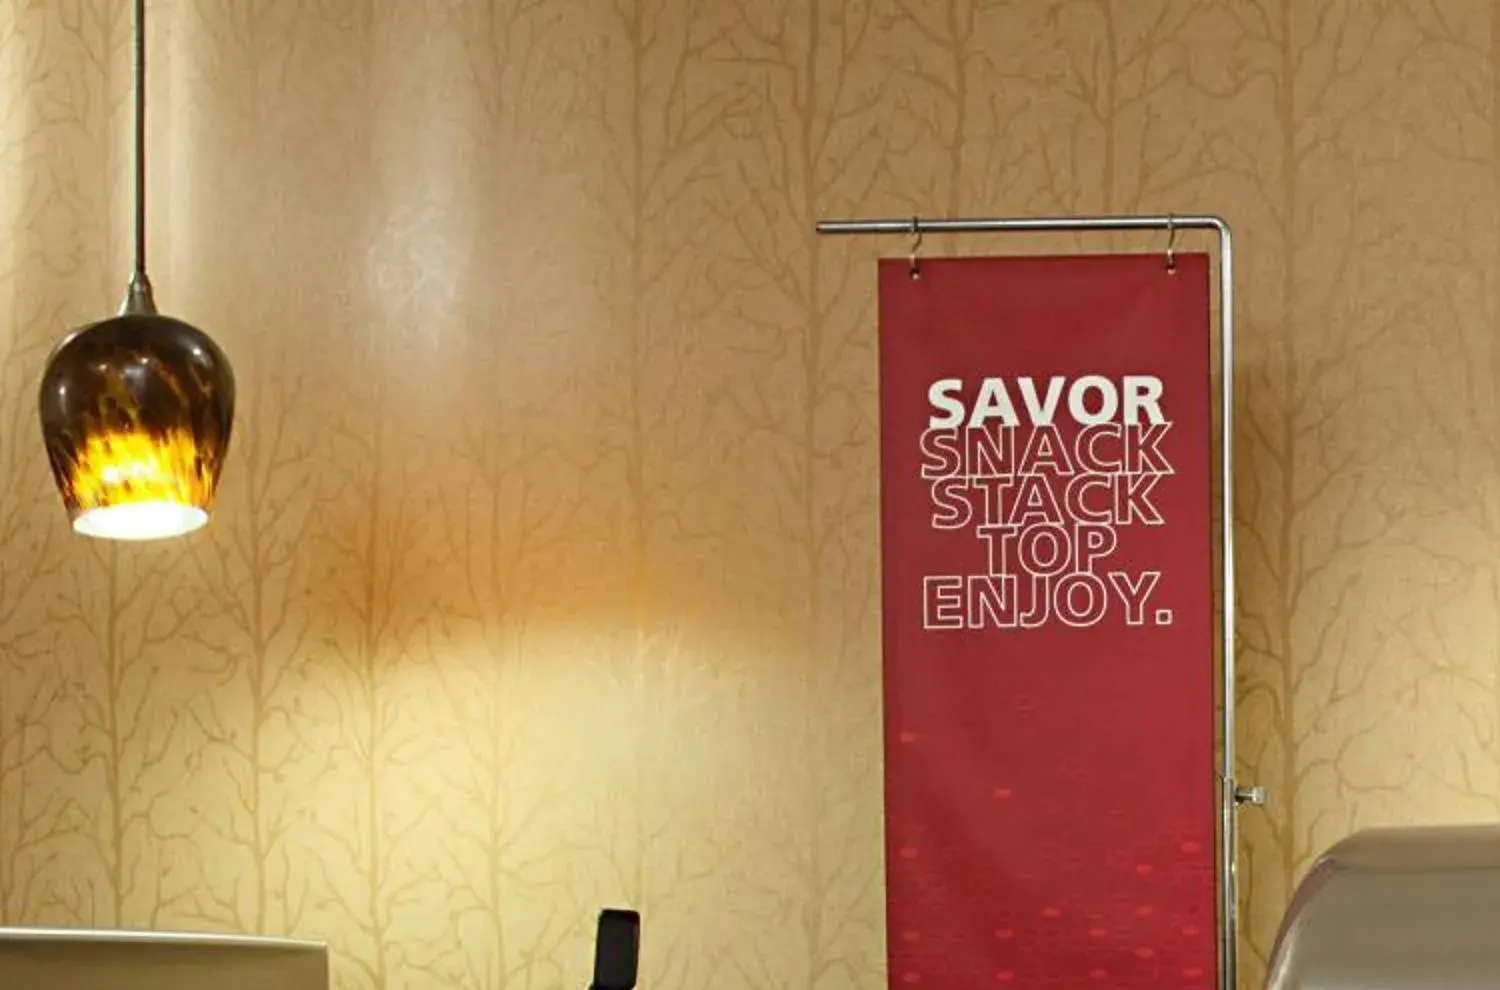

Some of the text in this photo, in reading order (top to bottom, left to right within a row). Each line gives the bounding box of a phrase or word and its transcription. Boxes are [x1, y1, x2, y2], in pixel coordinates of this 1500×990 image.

[927, 375, 1165, 429] SAVOR
[919, 422, 1175, 479] SNACK
[931, 472, 1165, 529] STACK
[976, 524, 1117, 577] TOP
[922, 571, 1173, 629] ENJOY.
